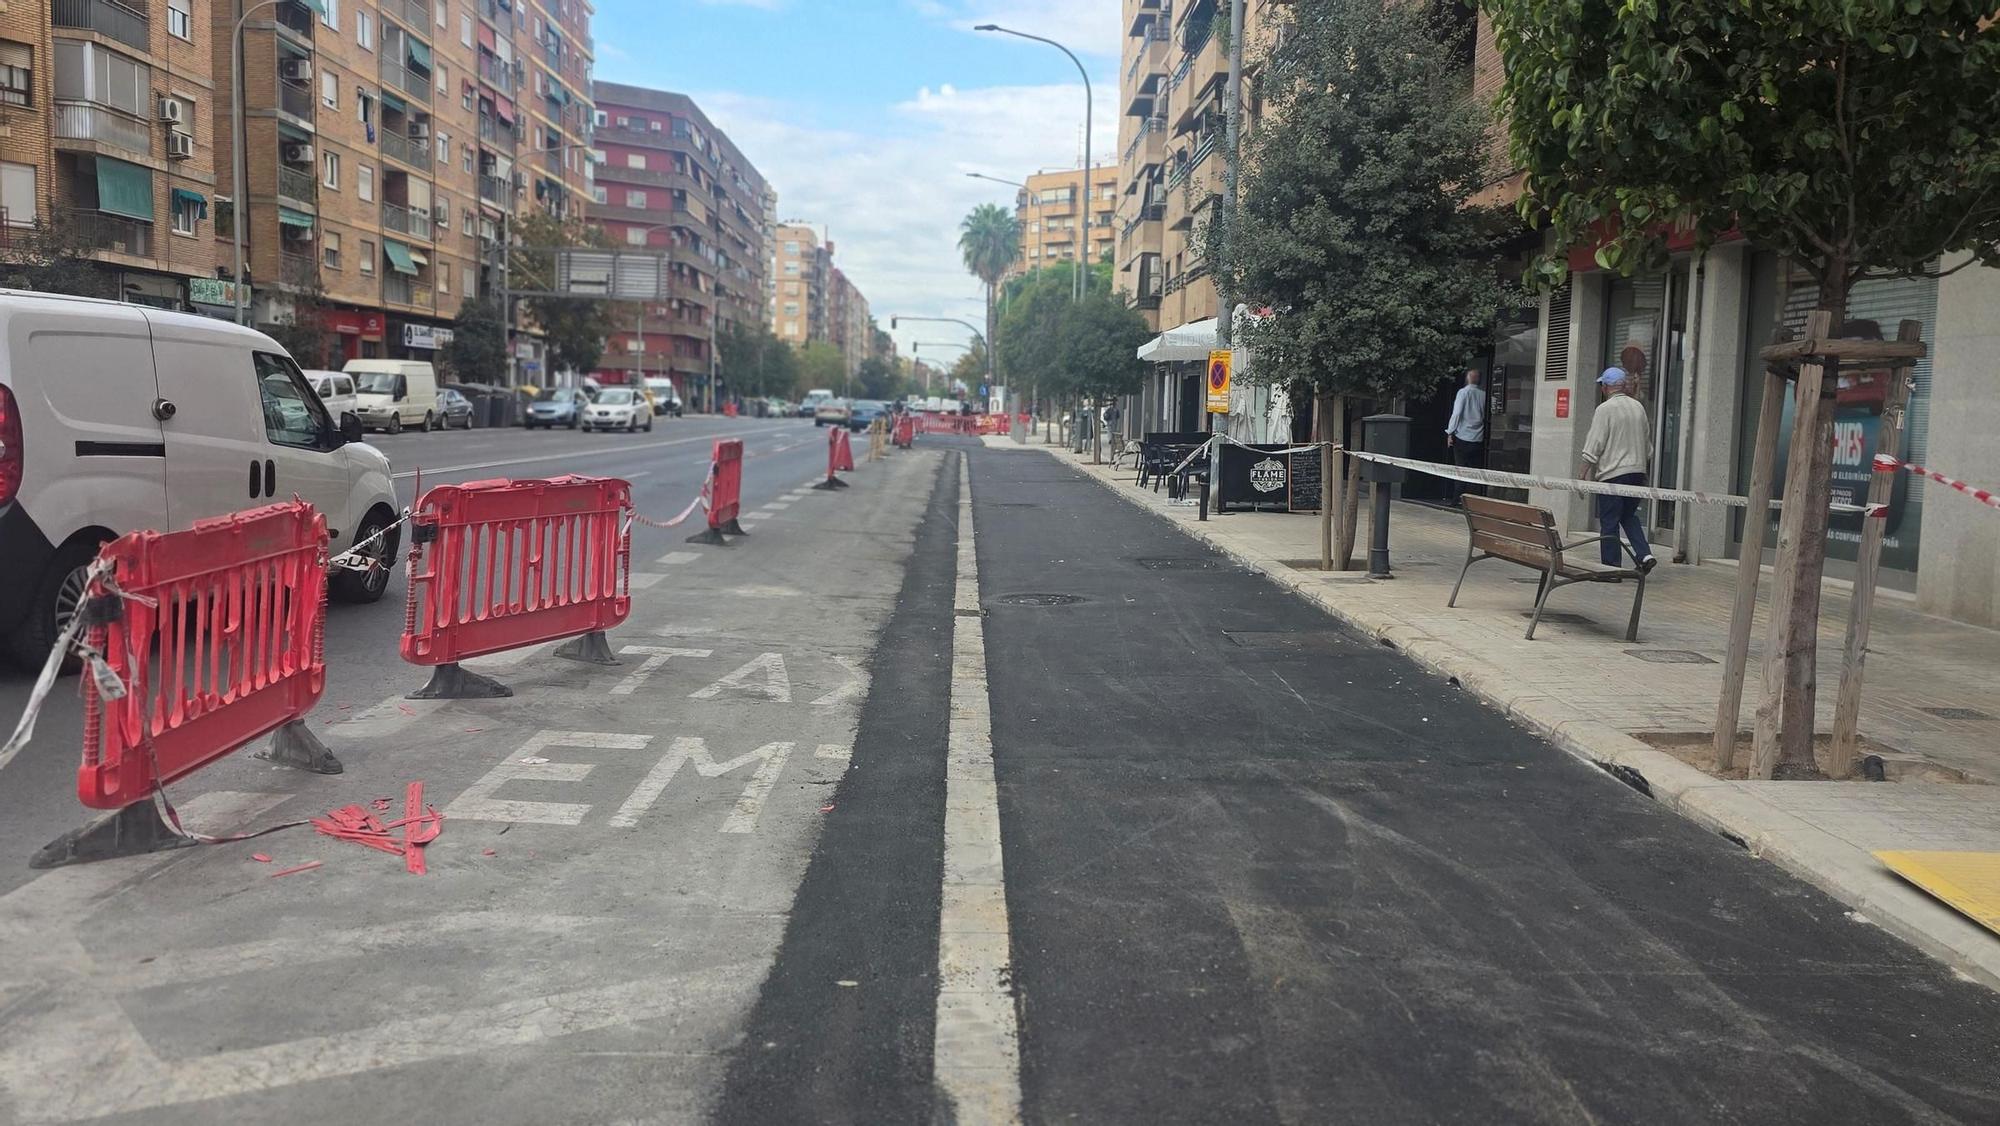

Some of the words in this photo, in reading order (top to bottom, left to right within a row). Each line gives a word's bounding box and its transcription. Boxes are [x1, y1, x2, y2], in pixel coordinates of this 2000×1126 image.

[1832, 422, 1863, 466] CHES
[1252, 470, 1284, 478] FLAME
[1835, 531, 1862, 543] CONFIANZ
[1882, 536, 1899, 548] PAÑA
